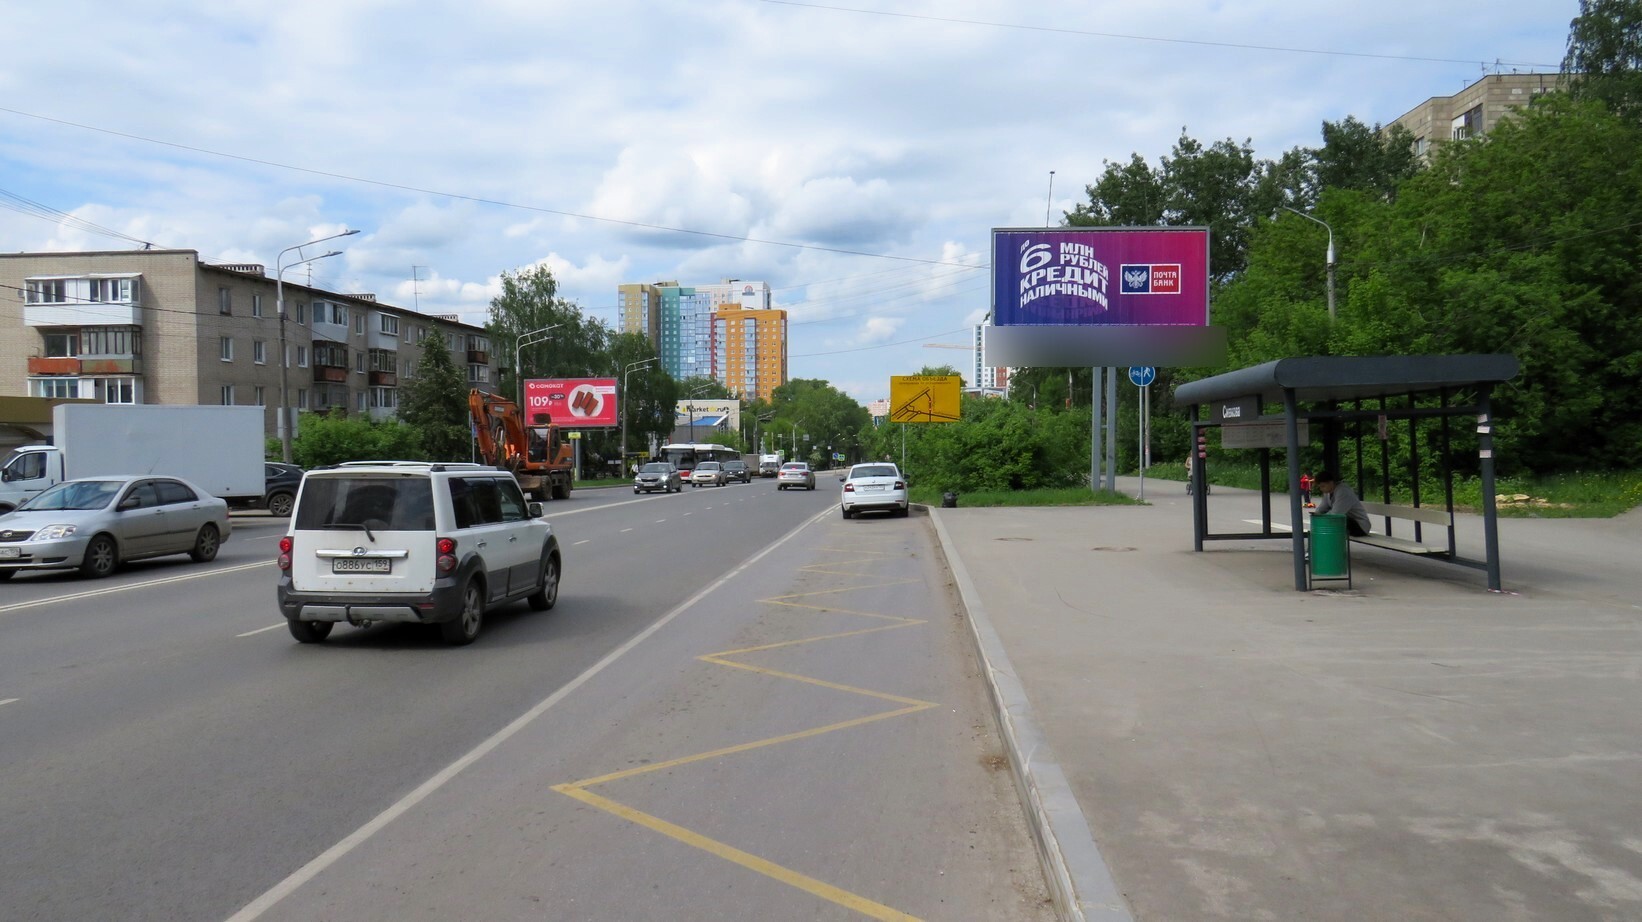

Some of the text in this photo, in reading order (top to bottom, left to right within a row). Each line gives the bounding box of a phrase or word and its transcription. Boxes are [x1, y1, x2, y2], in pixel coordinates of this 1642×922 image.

[1020, 239, 1030, 254] ДО
[1020, 242, 1094, 273] 6 МЛН
[1060, 253, 1109, 281] РУБЛЕЙ
[1020, 266, 1109, 295] КРЕДИТ
[1153, 271, 1177, 279] ПОЧТА
[1153, 279, 1174, 287] БАНК
[1020, 282, 1109, 311] НАЛИЧНЫМИ
[374, 559, 388, 568] 159
